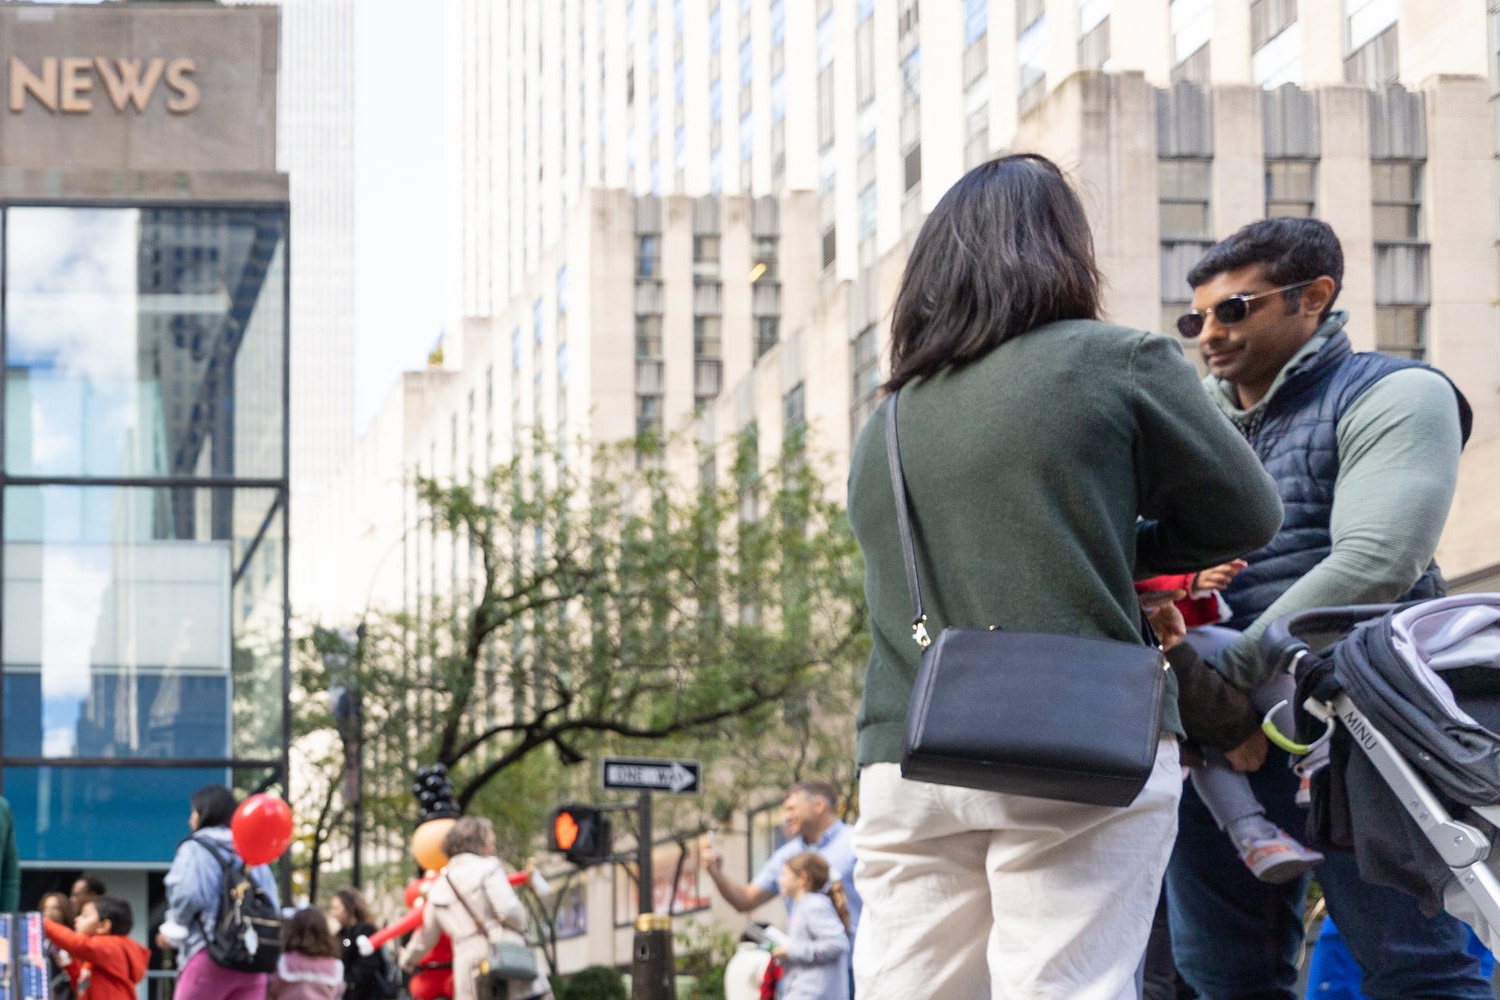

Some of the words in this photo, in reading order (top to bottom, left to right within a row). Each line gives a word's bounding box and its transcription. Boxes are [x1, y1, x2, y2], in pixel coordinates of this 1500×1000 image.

[8, 54, 200, 115] NEWS
[1343, 711, 1378, 750] MINU
[616, 766, 643, 785] ONE
[657, 767, 685, 786] WAY
